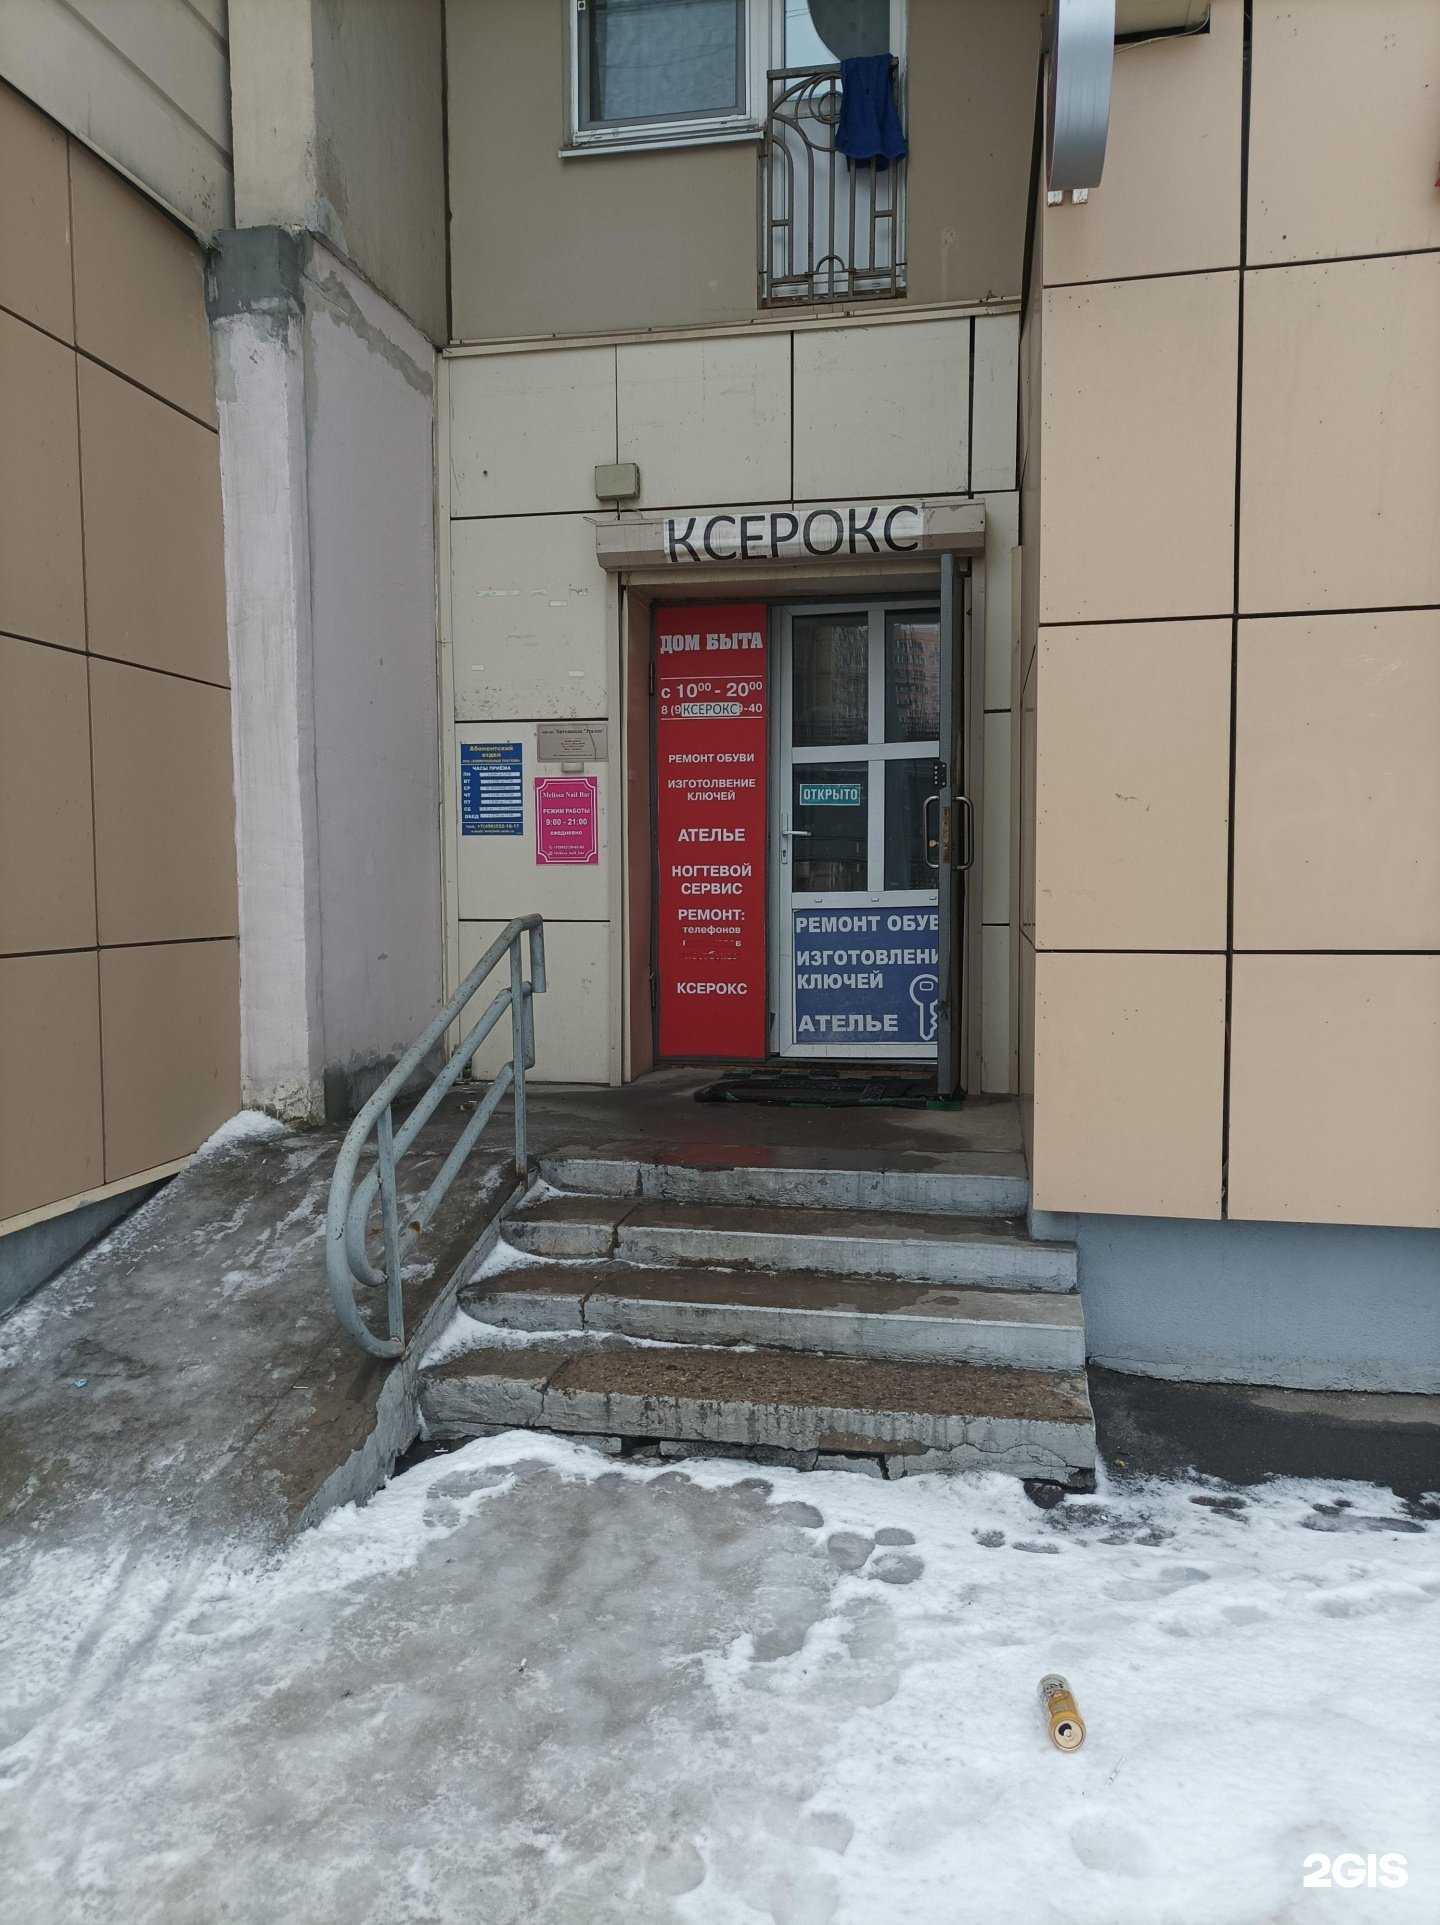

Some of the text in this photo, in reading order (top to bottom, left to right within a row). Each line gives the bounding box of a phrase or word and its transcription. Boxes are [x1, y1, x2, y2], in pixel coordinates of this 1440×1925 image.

[668, 505, 919, 562] КСЕРОКС
[660, 632, 763, 654] ДОМ БЫТА
[682, 703, 739, 715] КСЕРОКС
[668, 753, 755, 763] РЕМОНТ ОБУВИ
[667, 778, 756, 789] ИЗГОТОЛВЕНИЕ
[687, 791, 736, 801] КЛЮЧЕЙ
[803, 788, 858, 801] ОТКРЫТО
[677, 828, 746, 842] АТЕЛЬЕ
[671, 863, 752, 877] НОГТЕВОЙ
[681, 882, 743, 895] СЕРВИС
[678, 908, 745, 921] РЕМОНТ:
[683, 925, 741, 934] телефонов
[796, 914, 938, 933] РЕМОНТ ОБУВ
[797, 949, 938, 966] ИЗГОТОВЛЕНИ
[797, 970, 884, 989] КЛЮЧЕЙ
[677, 982, 748, 995] КСЕРОКС
[798, 1014, 899, 1032] АТЕЛЬЕ
